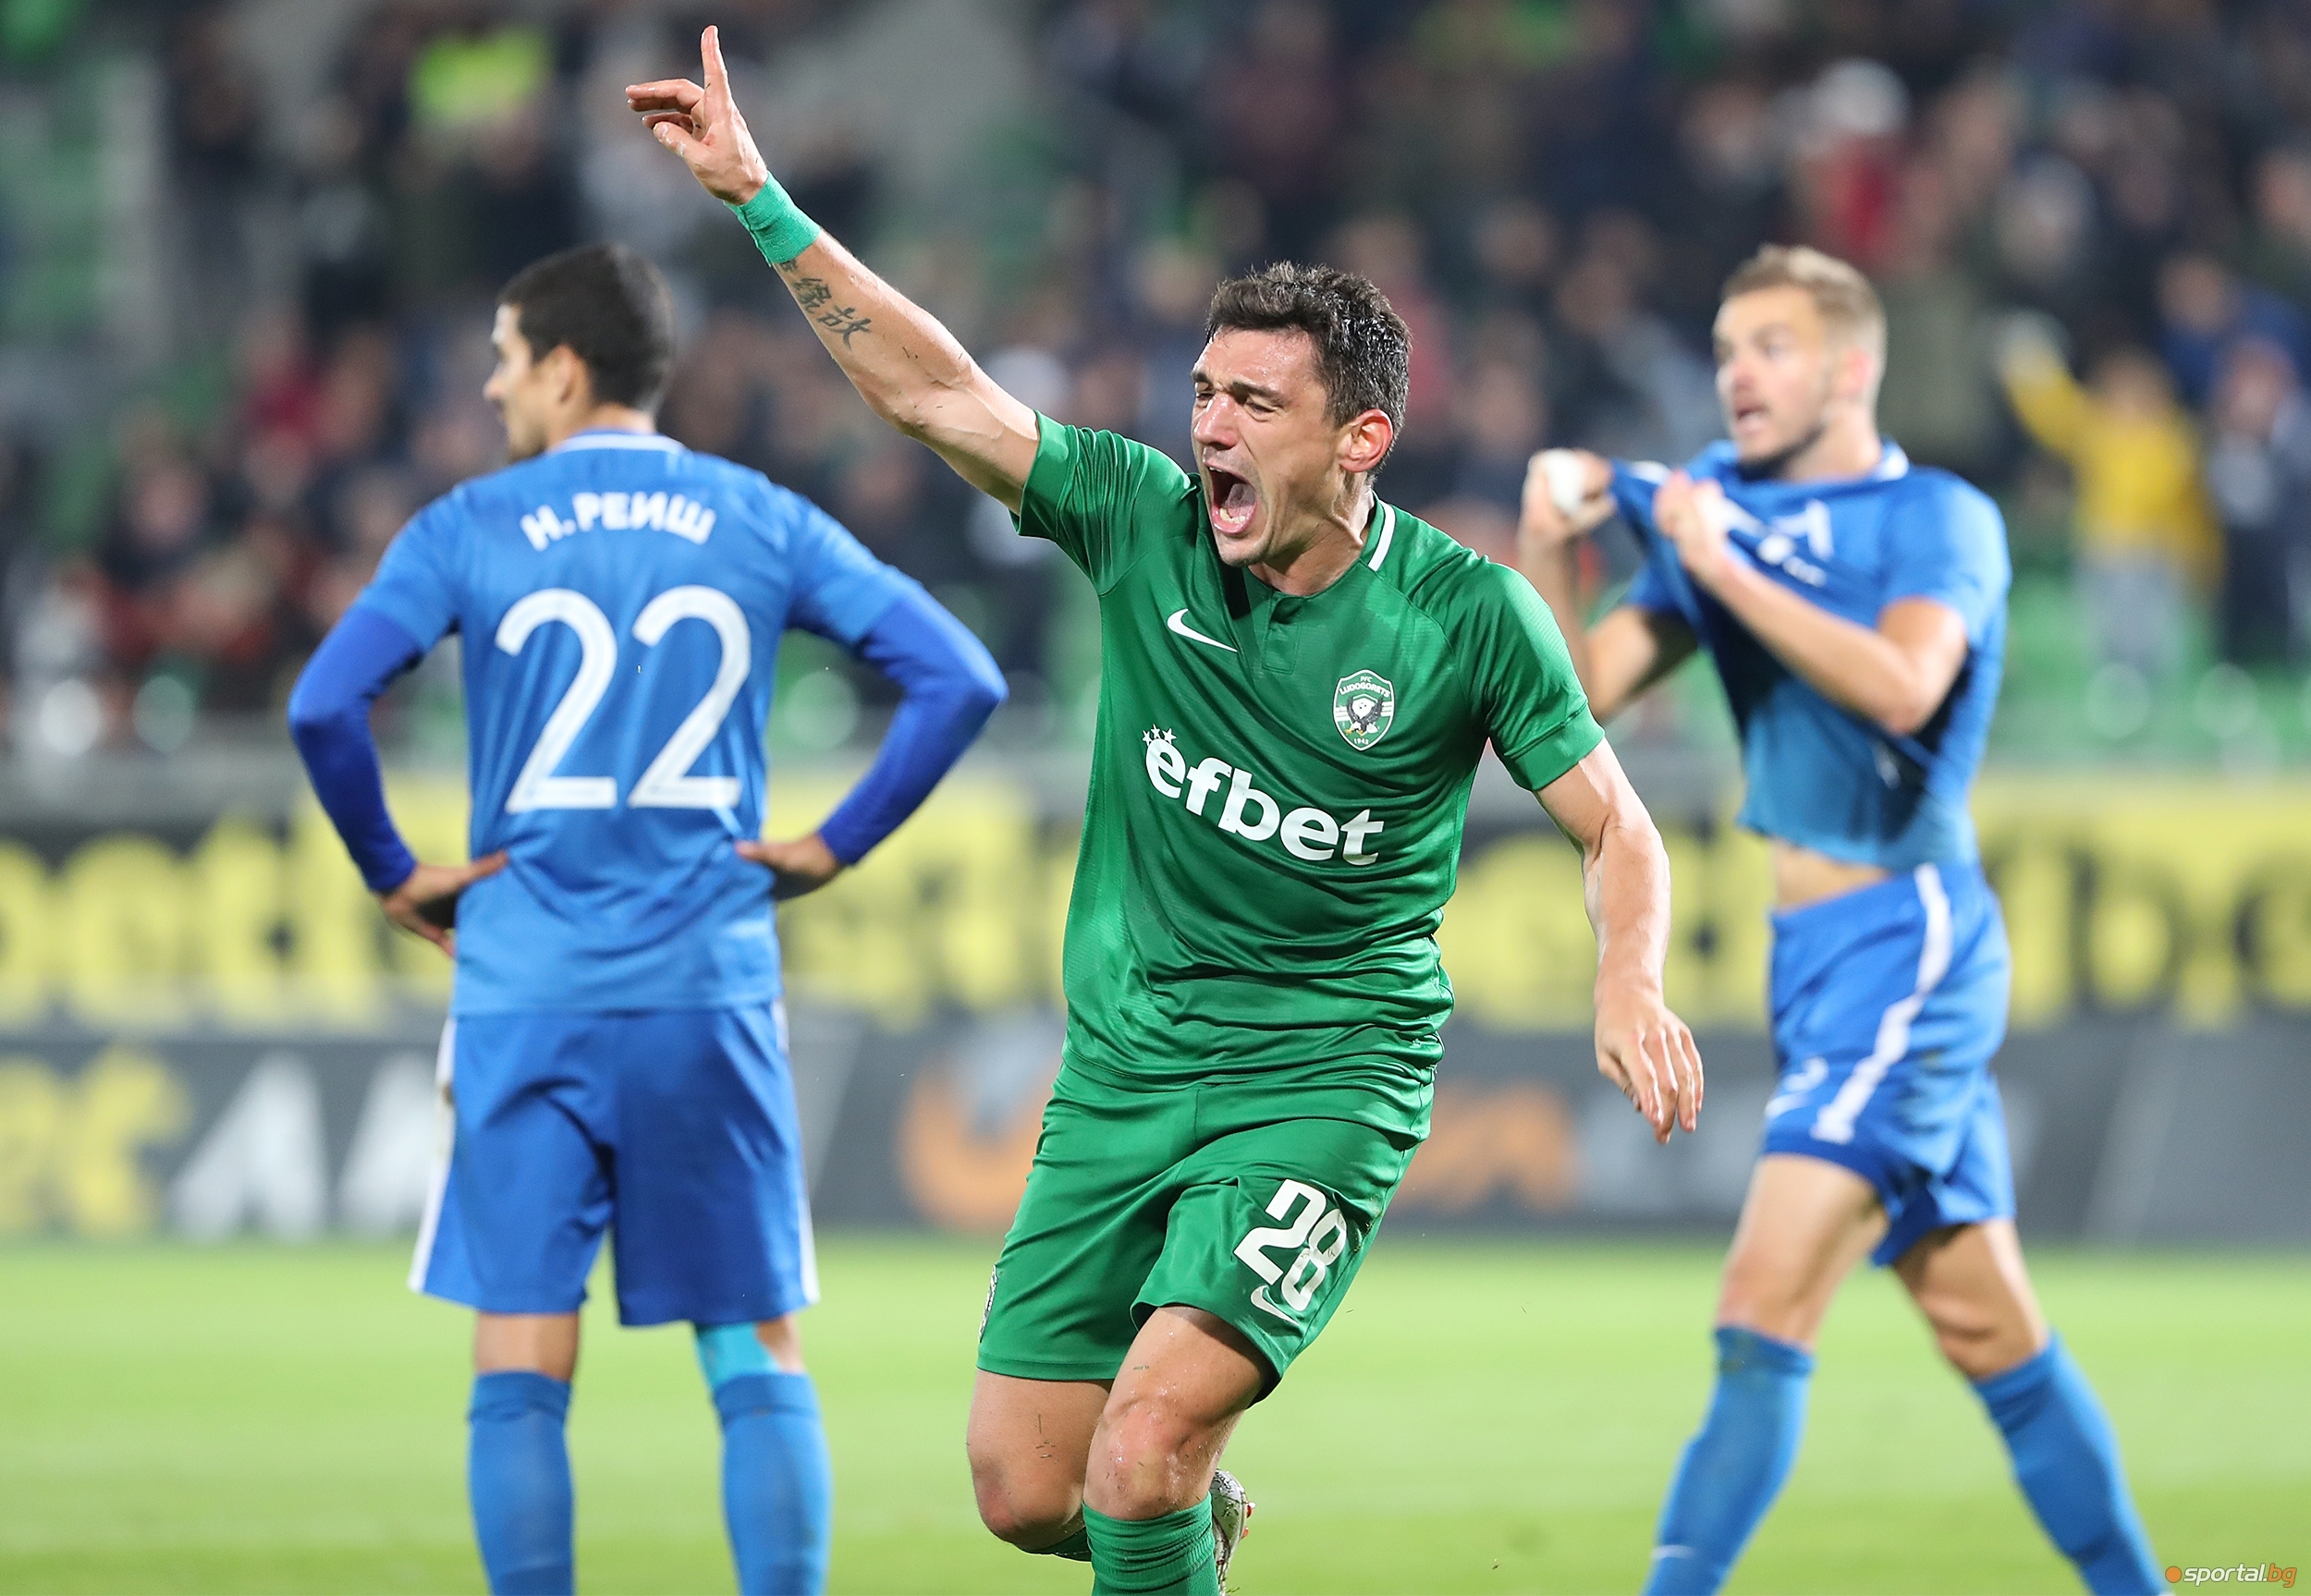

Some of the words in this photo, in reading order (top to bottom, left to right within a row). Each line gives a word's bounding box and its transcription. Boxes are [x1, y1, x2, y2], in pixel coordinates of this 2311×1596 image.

[495, 585, 752, 814] 22
[1339, 682, 1391, 698] LUDOGORETS
[1145, 738, 1385, 866] efbet
[1233, 1178, 1347, 1311] 28
